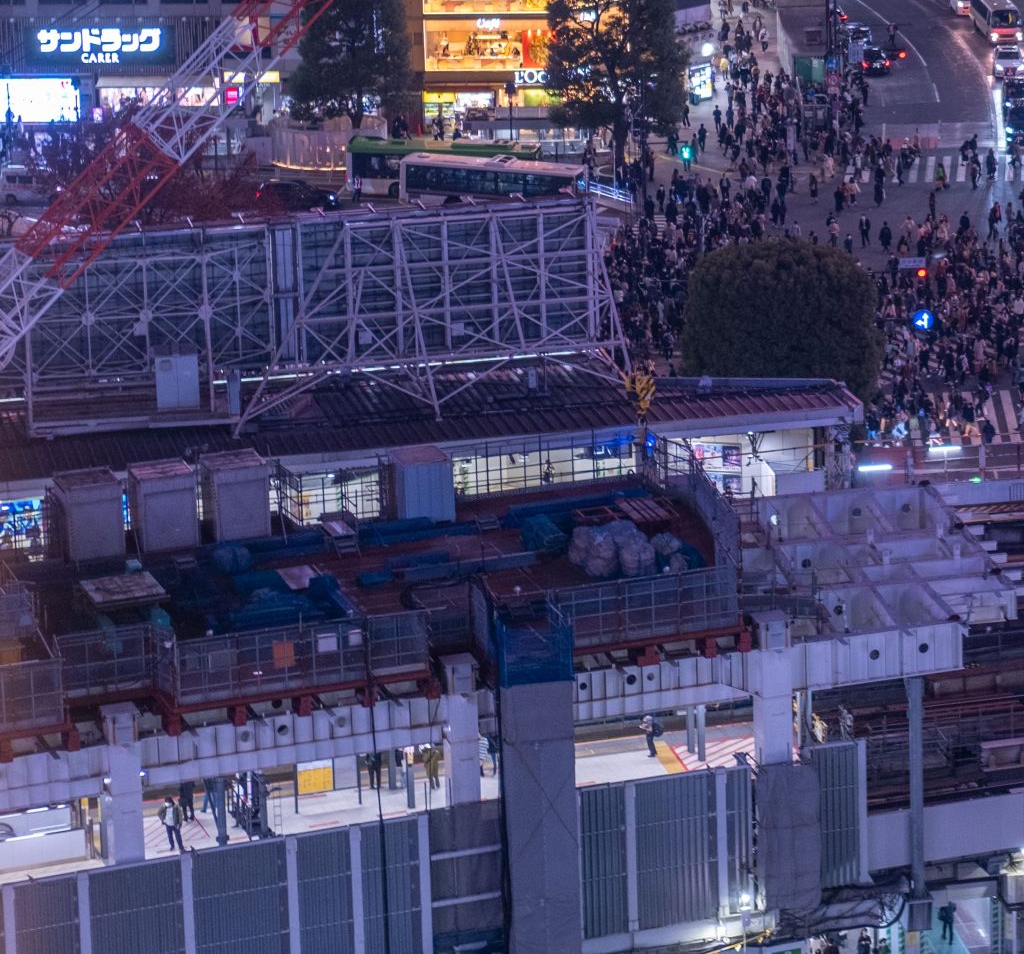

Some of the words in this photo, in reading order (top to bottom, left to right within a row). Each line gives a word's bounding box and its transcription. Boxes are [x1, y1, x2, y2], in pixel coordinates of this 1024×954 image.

[37, 28, 161, 52] サンドラッグ
